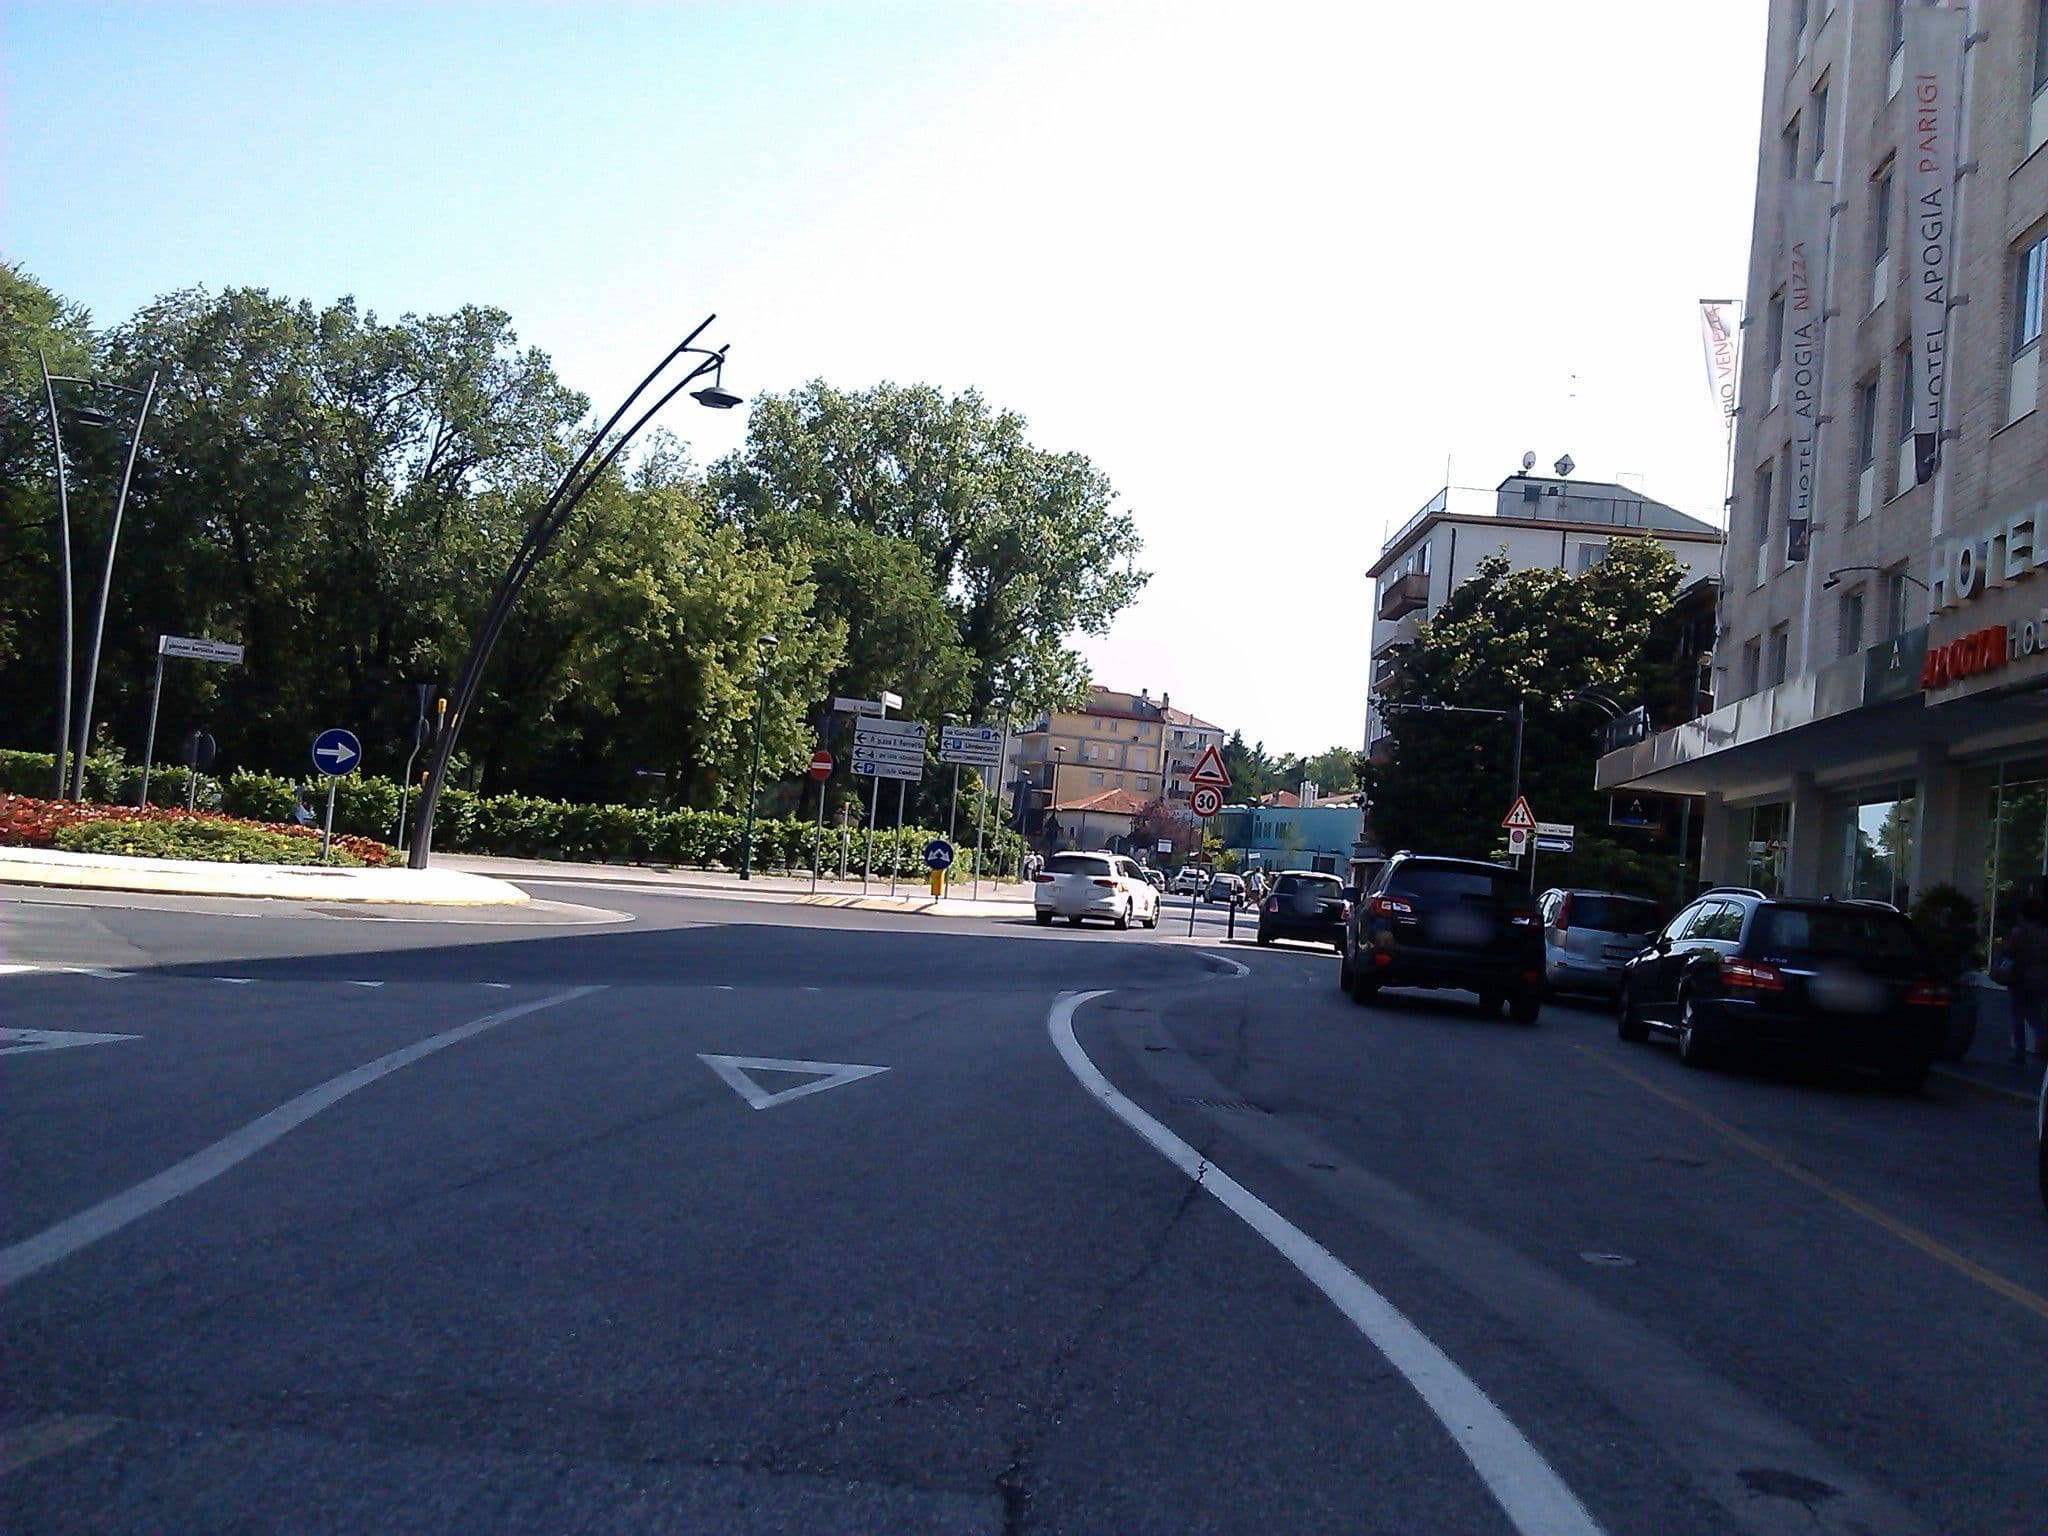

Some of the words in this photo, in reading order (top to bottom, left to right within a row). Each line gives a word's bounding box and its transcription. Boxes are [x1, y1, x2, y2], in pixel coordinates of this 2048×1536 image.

[1916, 74, 1939, 173] PARIGI
[1792, 242, 1808, 311] NIZZA
[1921, 187, 1945, 304] APOGIA
[1794, 323, 1812, 418] APOGIA
[1797, 438, 1812, 509] HOTEL
[1197, 794, 1216, 810] 30
